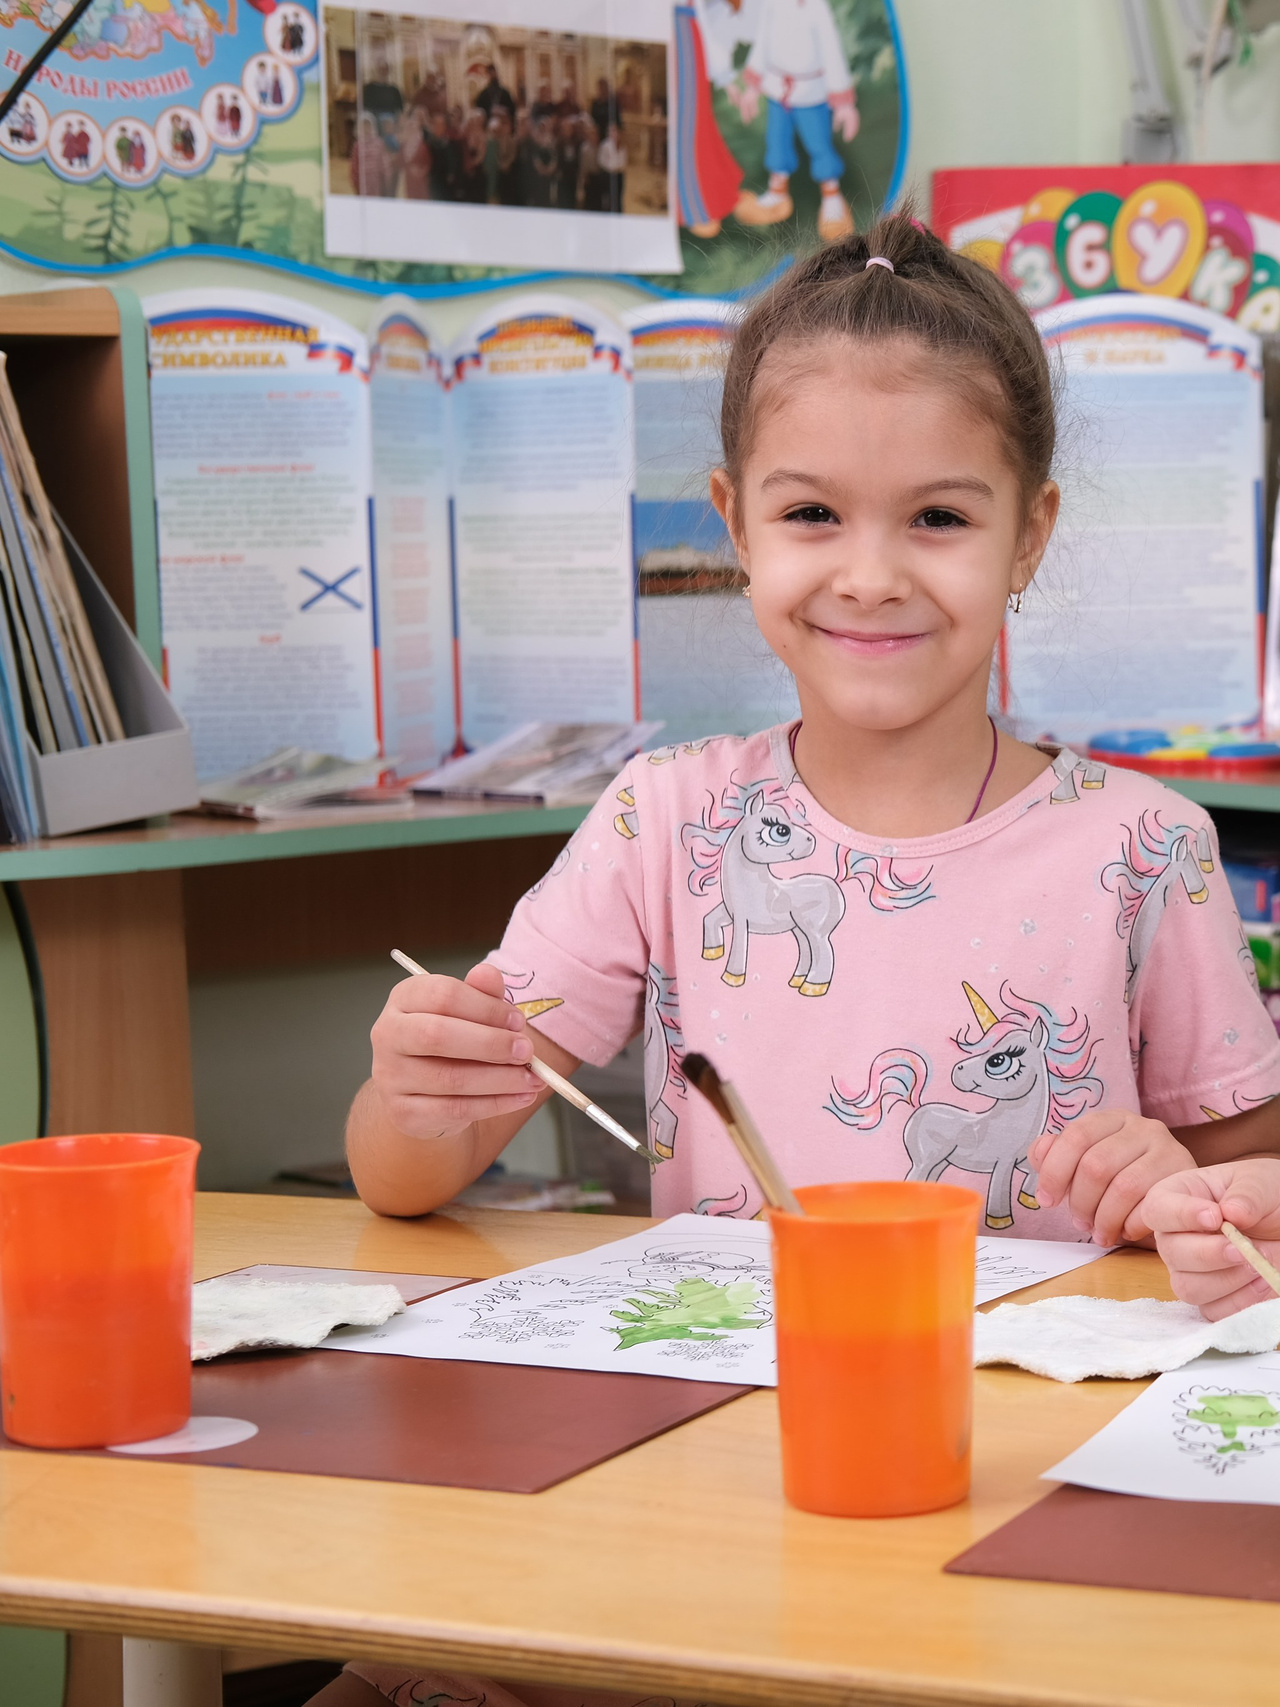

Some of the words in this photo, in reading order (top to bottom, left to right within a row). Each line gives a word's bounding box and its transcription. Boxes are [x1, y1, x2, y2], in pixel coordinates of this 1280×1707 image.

[4, 49, 99, 98] НРОДЫ
[106, 67, 192, 99] РОССИИ
[151, 327, 319, 346] УДАРСТВЕННАЯ
